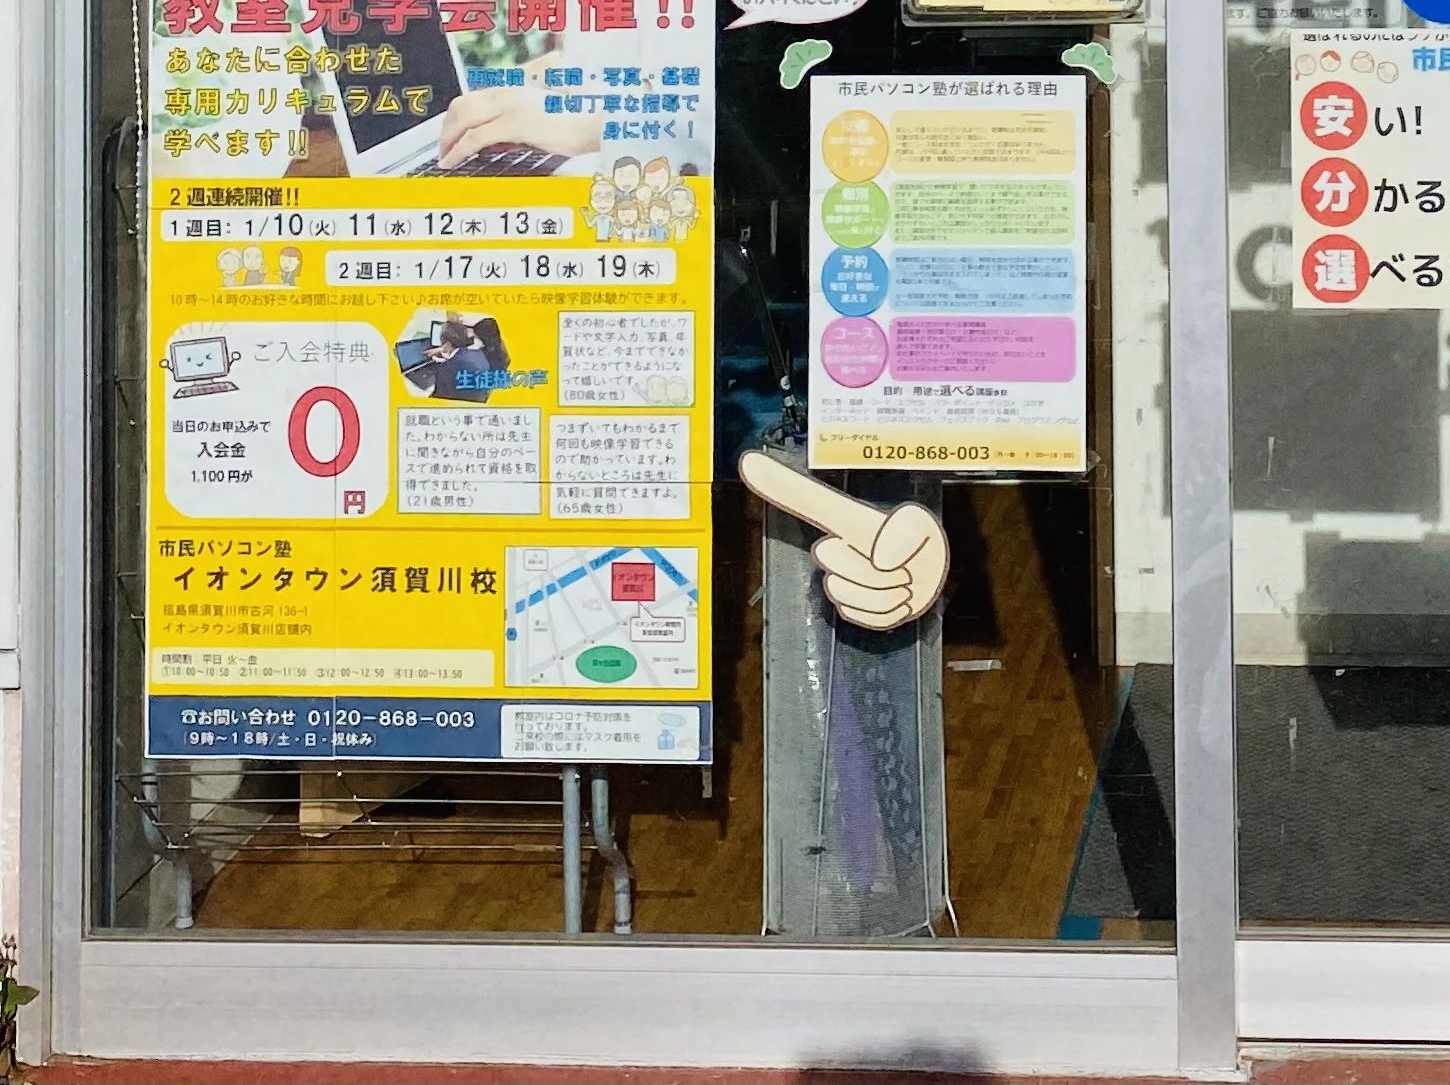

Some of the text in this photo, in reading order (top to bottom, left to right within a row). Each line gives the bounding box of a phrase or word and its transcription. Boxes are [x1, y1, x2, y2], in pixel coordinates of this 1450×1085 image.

[165, 46, 402, 73] あなたに合わせた
[838, 81, 1058, 96] 市民パソコン塾が選ばれる理由
[165, 86, 431, 115] 専用カリキュラムで
[543, 94, 701, 115] 親切丁寧な指導で
[164, 128, 309, 159] 学べます!!
[170, 186, 300, 207] 2週連続開催!!
[245, 212, 337, 237] 1/10(火)
[348, 213, 412, 237] 11(水)
[424, 212, 488, 236] 12(木)
[498, 212, 564, 235] 13(金)
[414, 255, 507, 280] 1/17(火)
[521, 255, 584, 279] 18(水)
[597, 254, 661, 278] 19(木)
[253, 340, 371, 364] ご入会特典
[455, 370, 548, 391] 生徒様の声
[172, 417, 272, 435] 当日のお申込みで
[288, 385, 361, 478] 0
[196, 441, 247, 459] 入会金
[556, 438, 674, 450] 何回も映像学習できる
[862, 446, 990, 460] 0120-868-003
[343, 489, 366, 514] 円
[159, 539, 292, 559] 市民パソコン塾
[172, 566, 499, 595] イオンタウン須賀川校
[307, 710, 475, 729] 0120-868-003
